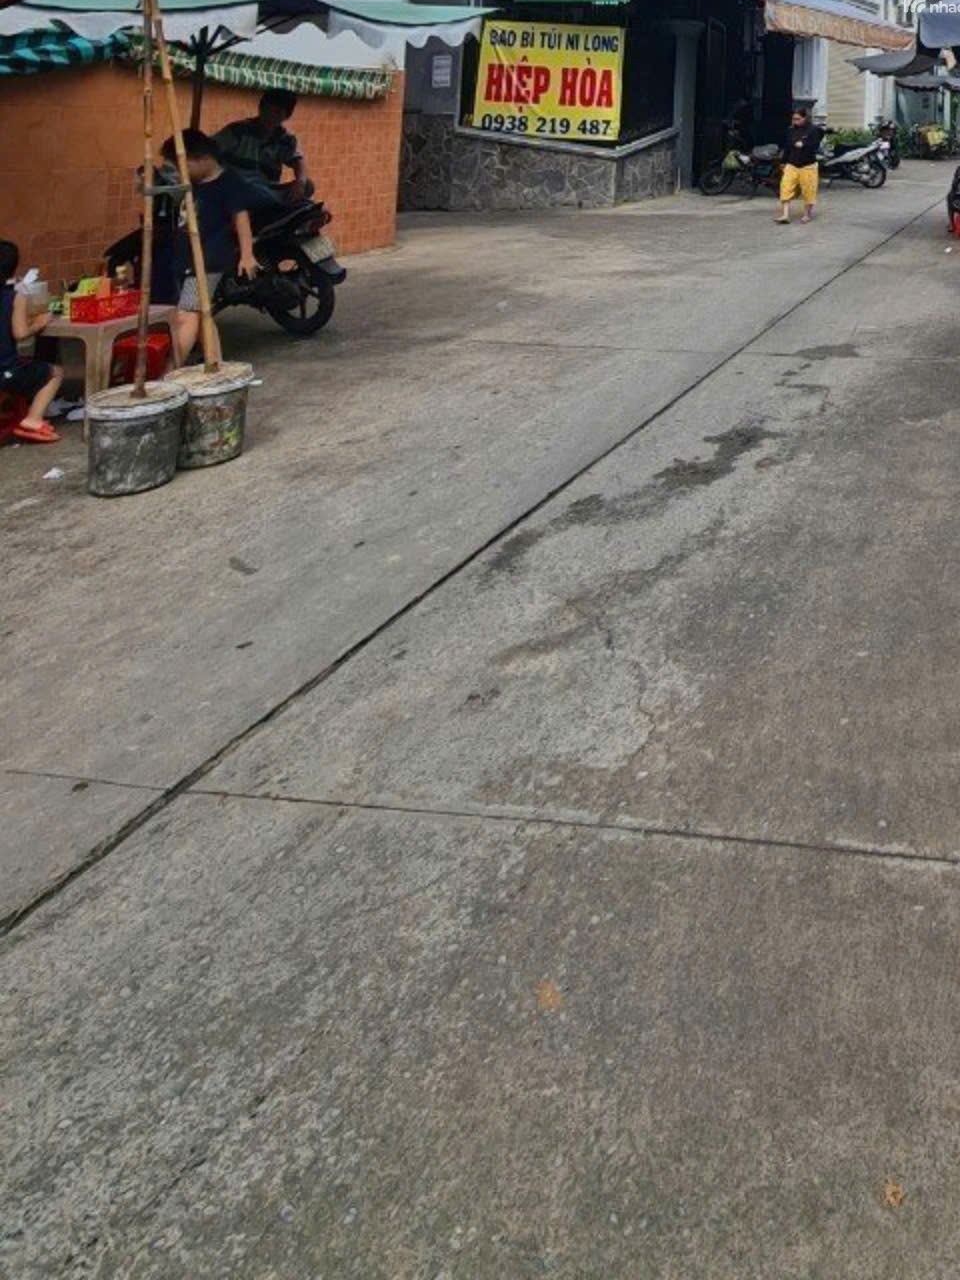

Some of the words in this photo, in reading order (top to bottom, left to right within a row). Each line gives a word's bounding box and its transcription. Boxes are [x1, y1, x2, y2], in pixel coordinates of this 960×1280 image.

[565, 33, 579, 51] NI
[583, 34, 619, 52] LONG
[484, 55, 551, 113] HIỆP
[558, 57, 614, 108] HÒA
[481, 113, 529, 134] 0938
[535, 117, 571, 135] 219
[576, 119, 612, 136] 487
